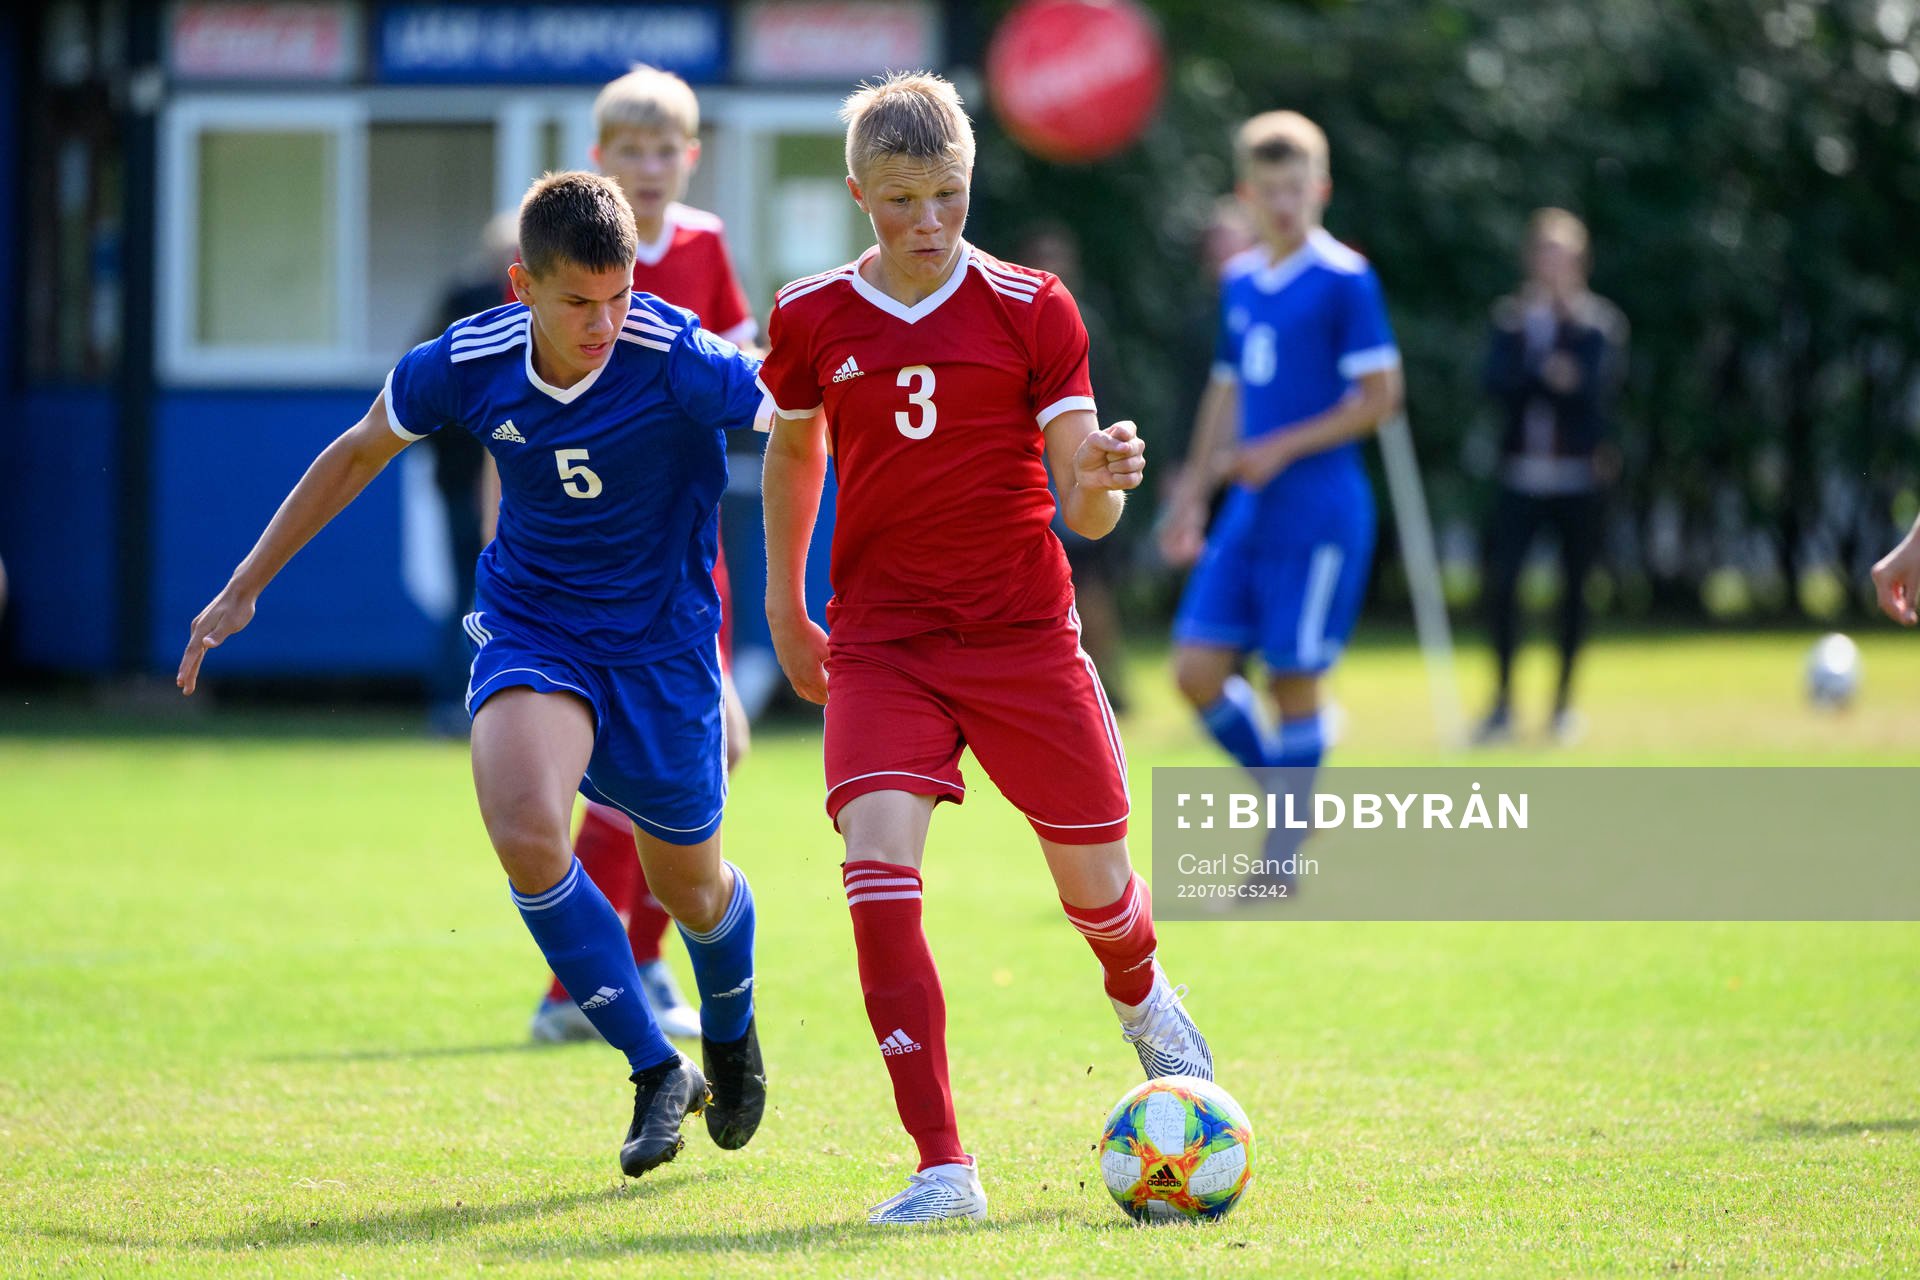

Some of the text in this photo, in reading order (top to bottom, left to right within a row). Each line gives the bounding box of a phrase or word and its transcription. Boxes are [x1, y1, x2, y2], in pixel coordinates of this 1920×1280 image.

[895, 365, 937, 440] 3
[492, 432, 526, 444] adidas
[555, 448, 602, 499] 5
[884, 1042, 922, 1057] didas
[1147, 1178, 1182, 1187] adidas
